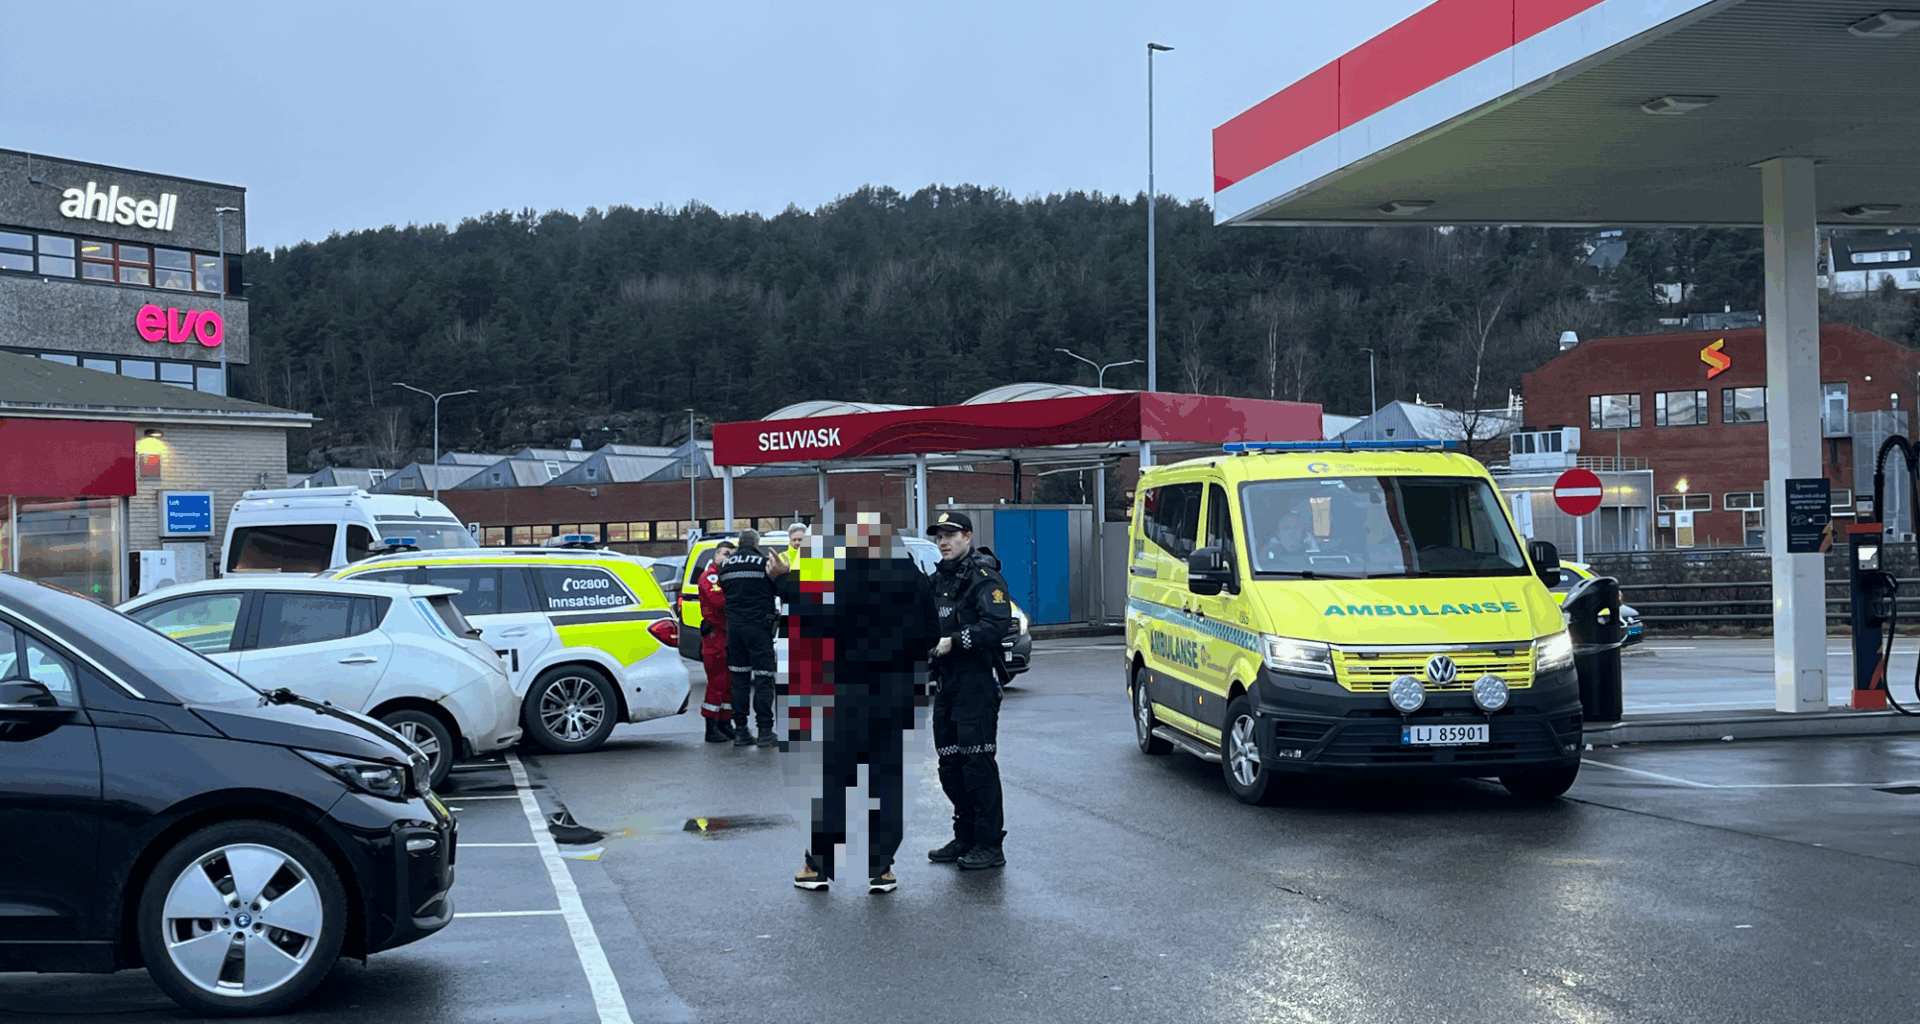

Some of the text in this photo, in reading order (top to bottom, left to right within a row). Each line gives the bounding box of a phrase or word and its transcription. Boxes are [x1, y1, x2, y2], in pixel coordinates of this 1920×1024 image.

[60, 182, 177, 231] ahlsell
[136, 304, 223, 347] evo
[758, 428, 841, 451] SELVVASK
[471, 525, 477, 537] P
[722, 555, 763, 568] POLITI
[572, 579, 609, 590] 02800
[549, 594, 627, 608] Innsatsleder
[1324, 602, 1522, 616] AMBULANSE
[1151, 629, 1199, 670] AMBULANSE
[1417, 727, 1483, 741] LJ 85901
